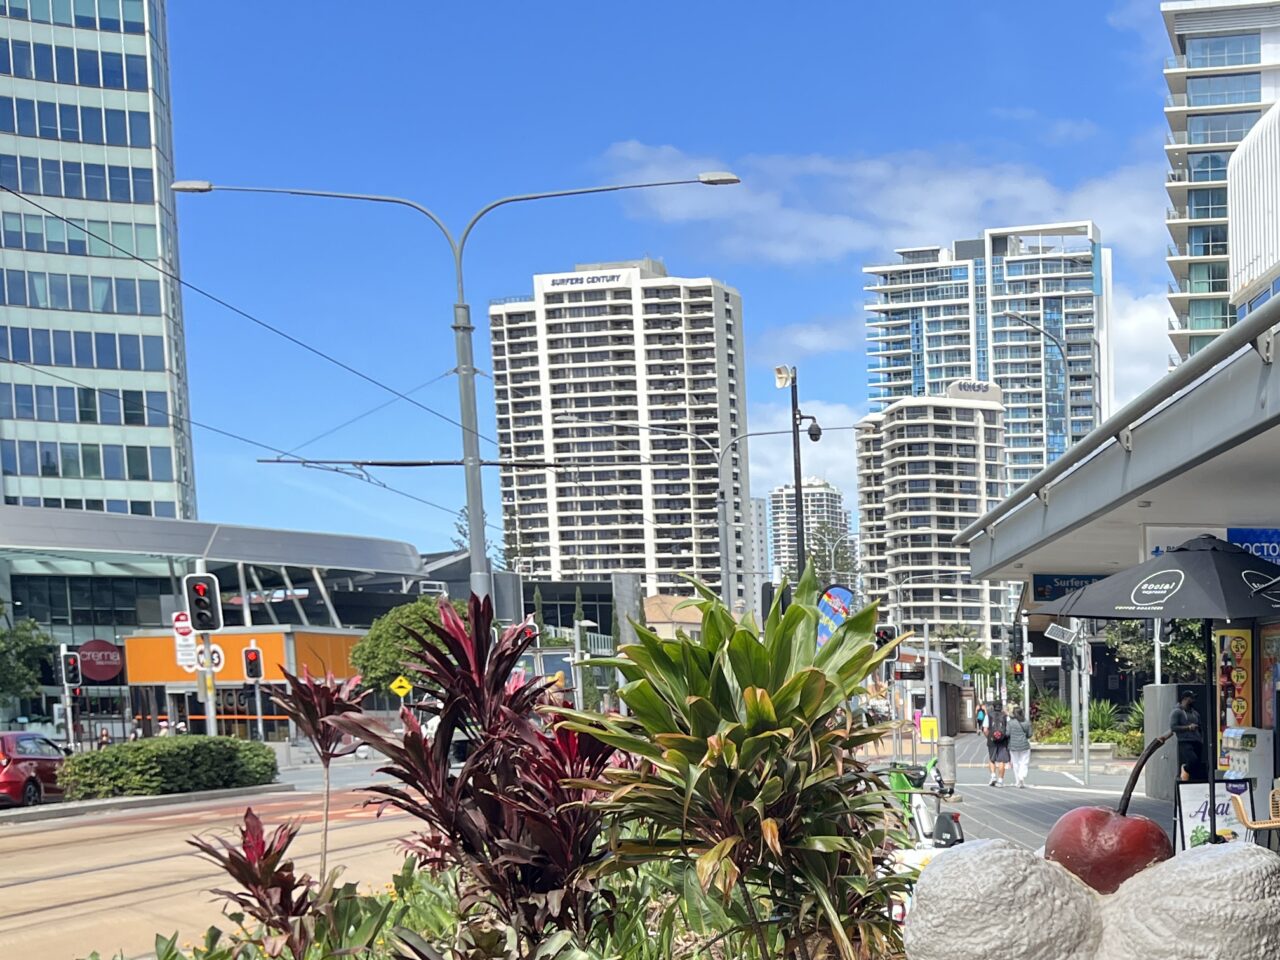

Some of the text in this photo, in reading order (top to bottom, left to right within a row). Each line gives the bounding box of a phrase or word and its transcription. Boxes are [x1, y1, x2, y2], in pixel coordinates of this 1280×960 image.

[551, 275, 621, 286] SURFERS CENTURY
[1054, 578, 1090, 587] Surfers
[1141, 582, 1176, 590] social
[79, 650, 120, 661] crema
